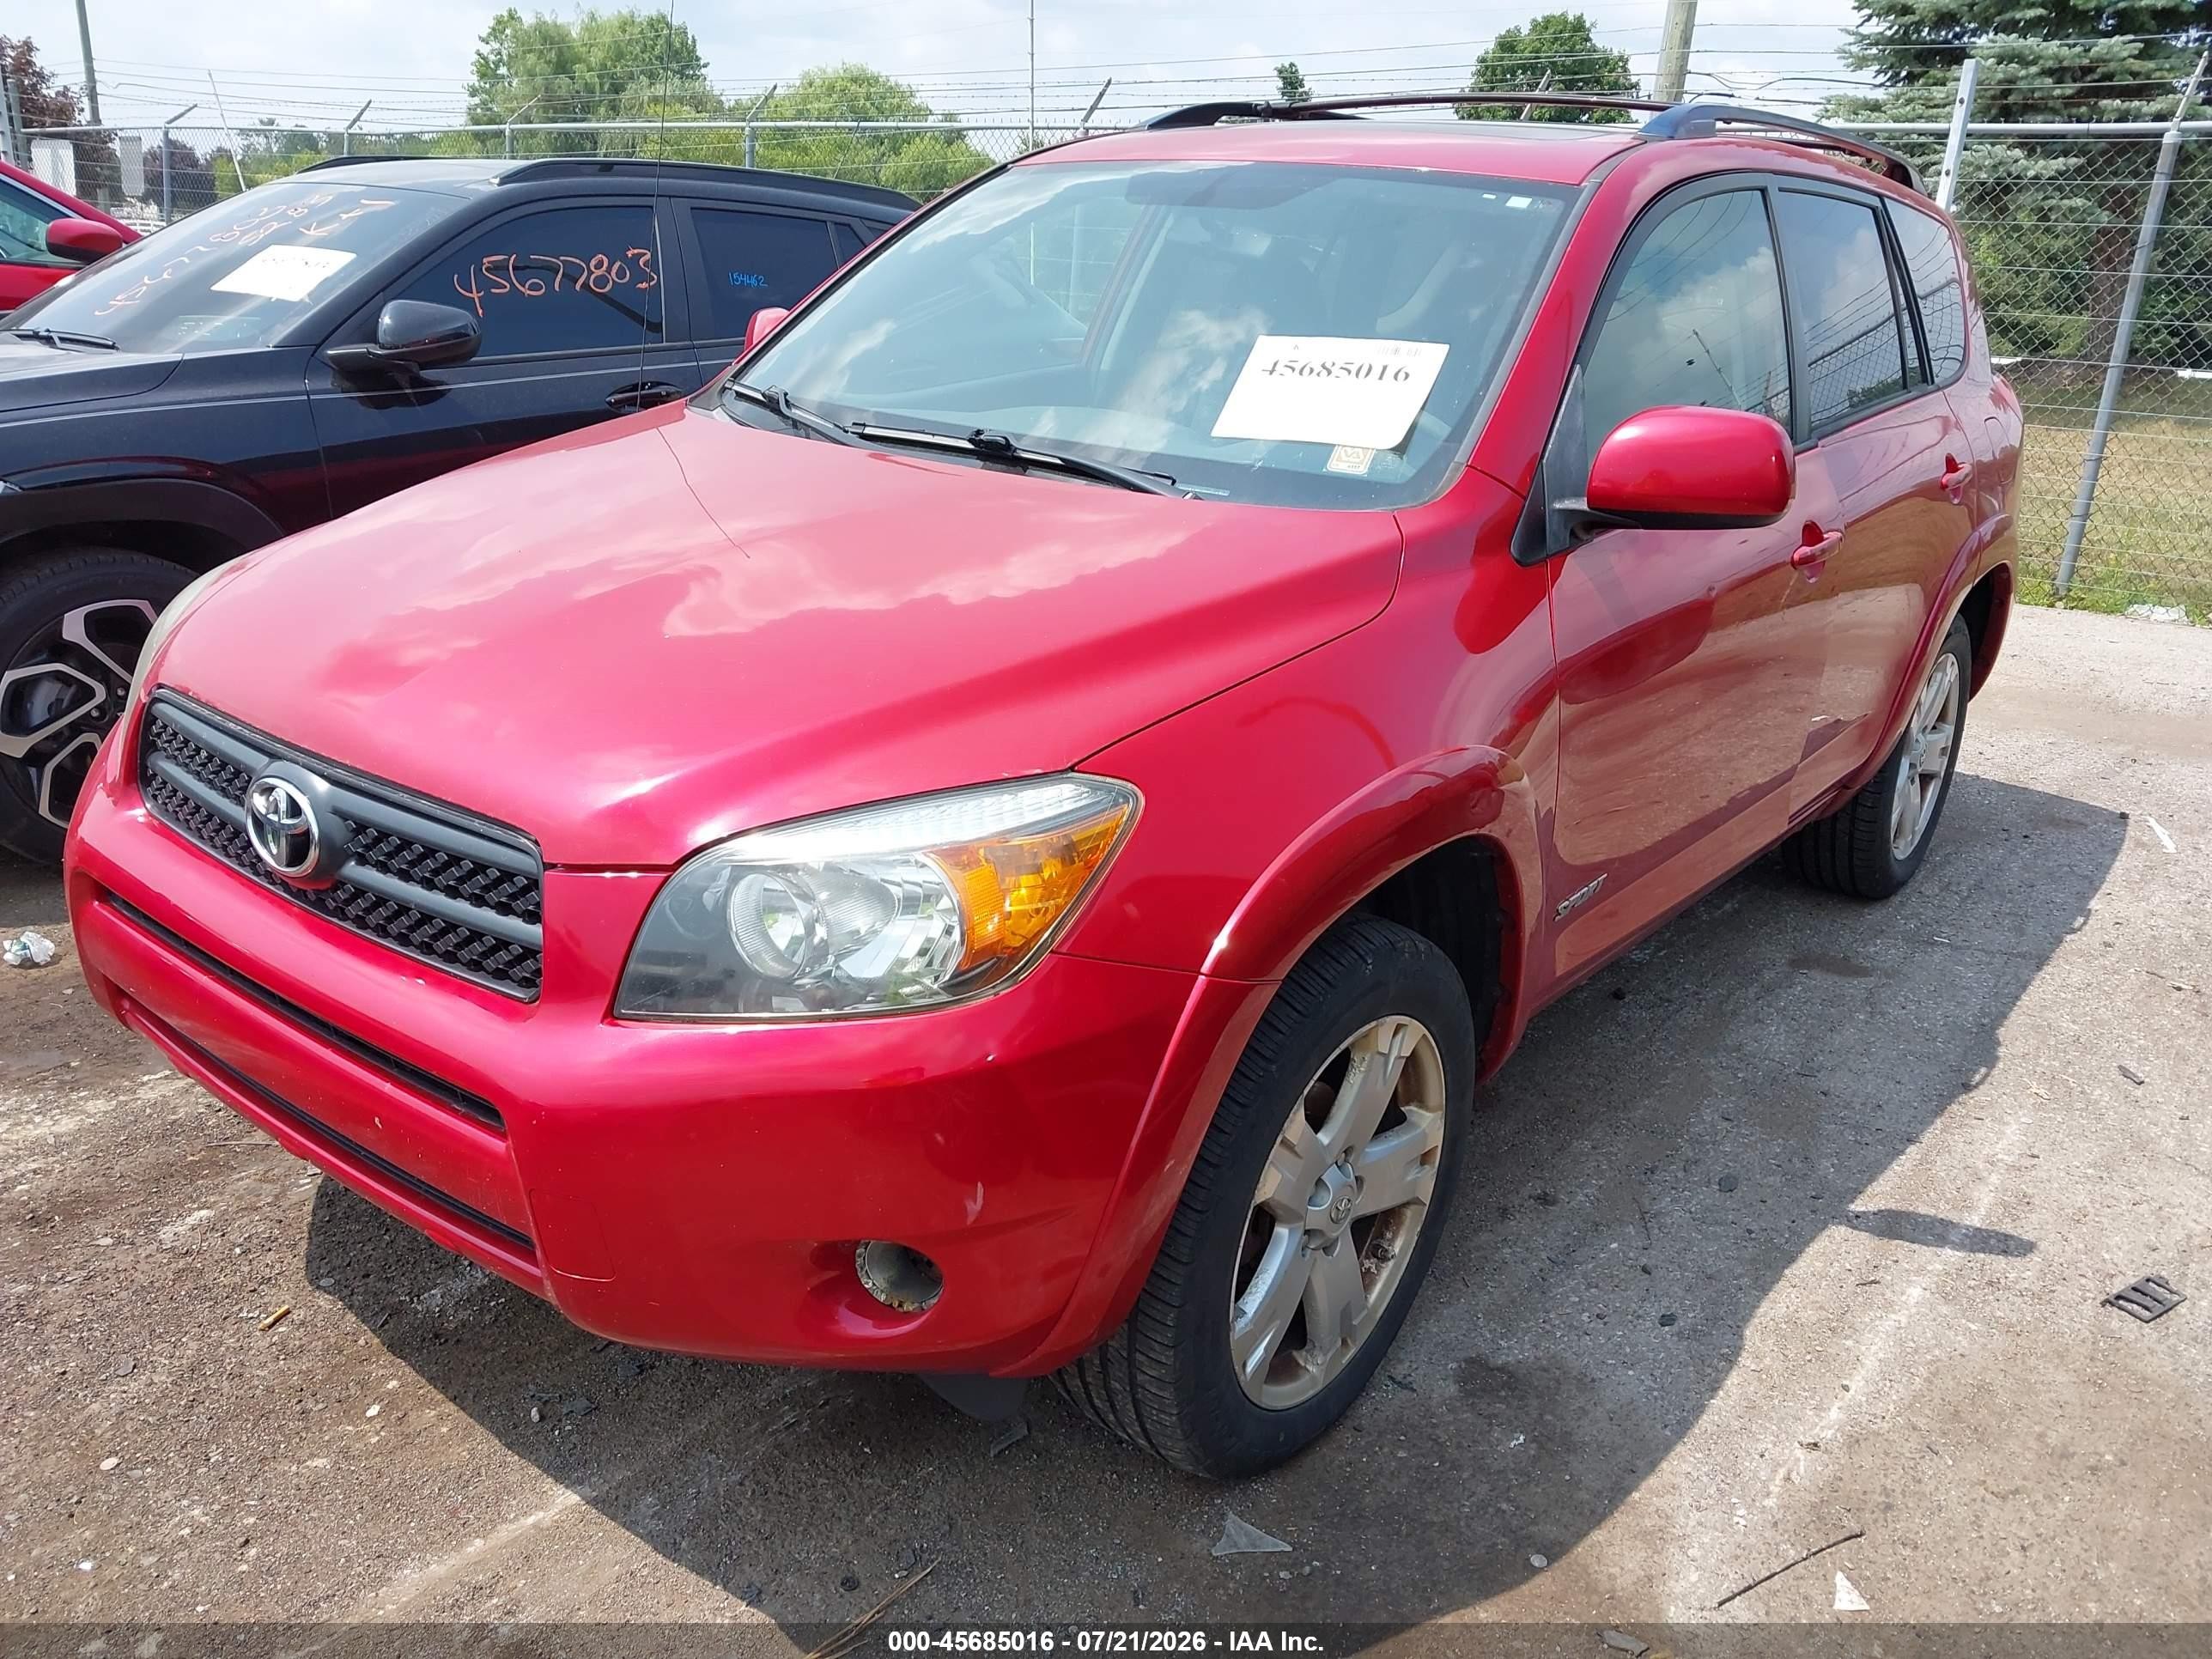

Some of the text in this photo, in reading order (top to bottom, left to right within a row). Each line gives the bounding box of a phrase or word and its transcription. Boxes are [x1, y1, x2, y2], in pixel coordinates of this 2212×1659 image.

[453, 246, 658, 317] 45677803
[728, 271, 769, 289] 154462
[1261, 358, 1411, 383] 45685016
